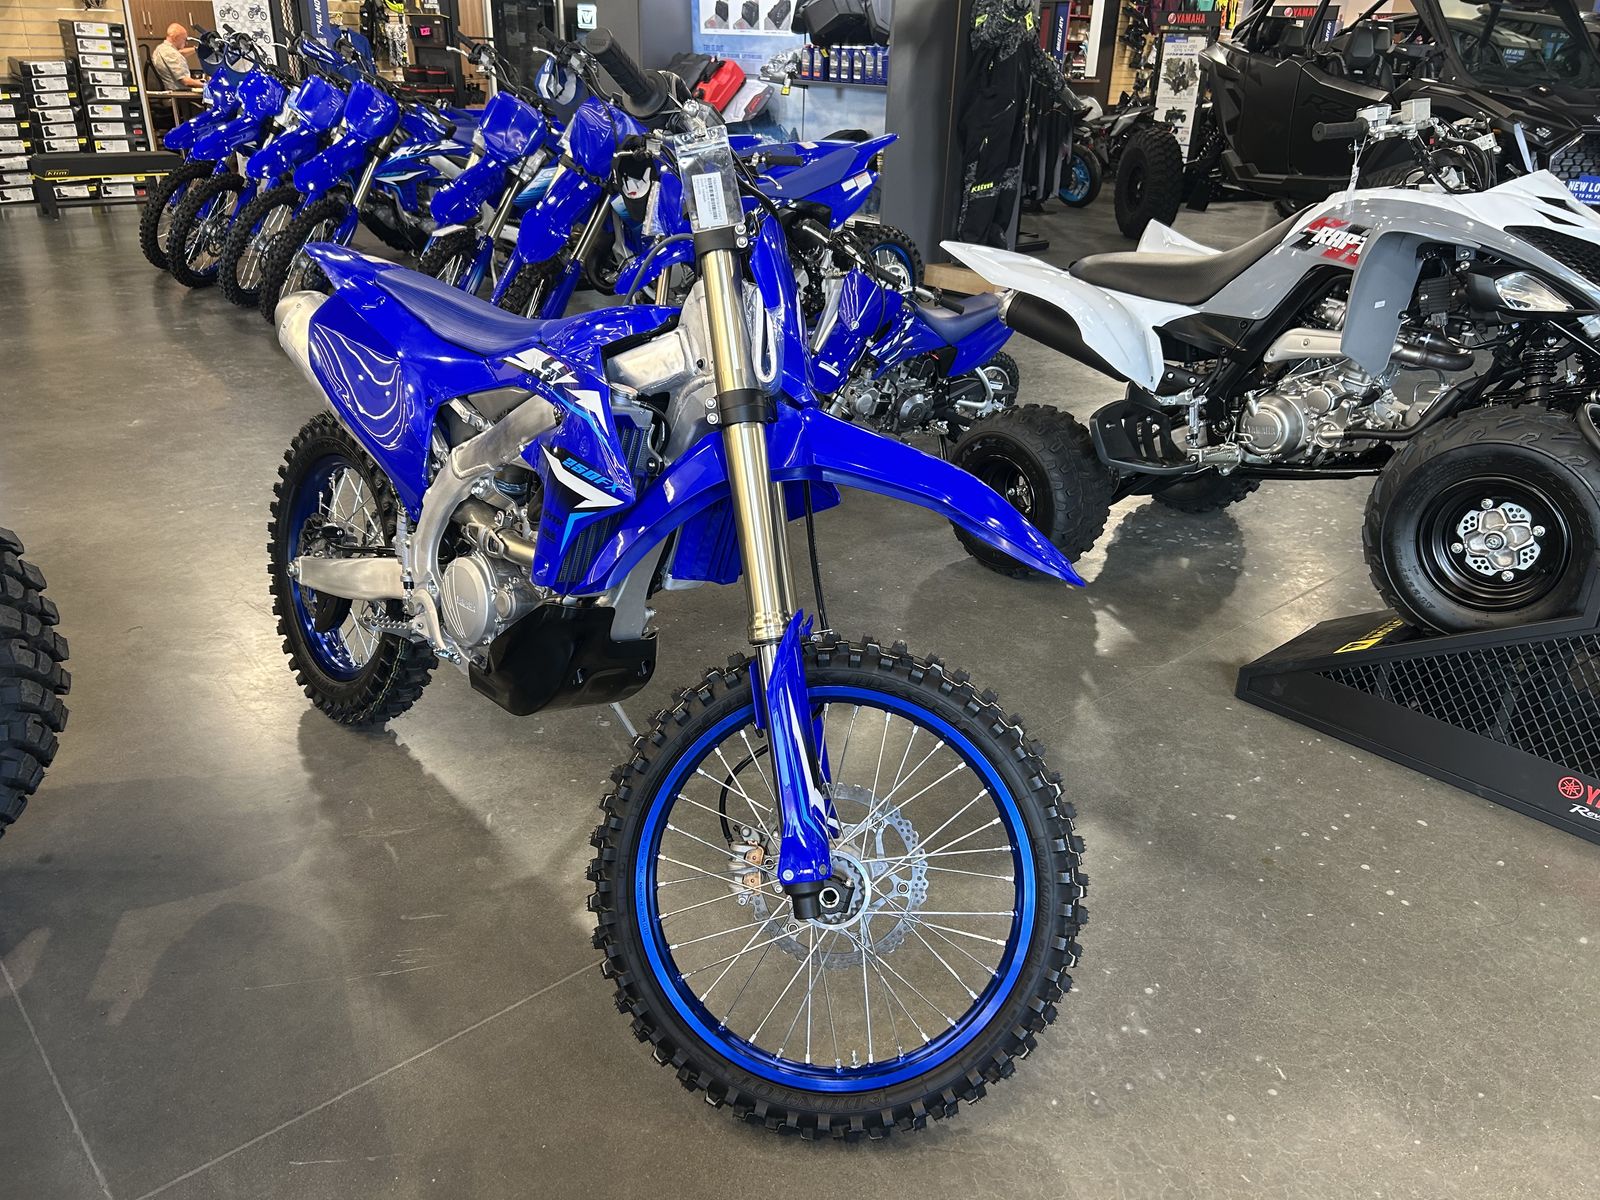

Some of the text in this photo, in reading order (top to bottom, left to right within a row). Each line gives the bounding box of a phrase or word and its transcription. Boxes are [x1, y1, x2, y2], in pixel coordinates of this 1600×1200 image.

[315, 13, 324, 35] TRAIL
[1176, 13, 1206, 24] YAMAHA
[1568, 180, 1588, 192] NEW
[562, 457, 621, 494] 250FX
